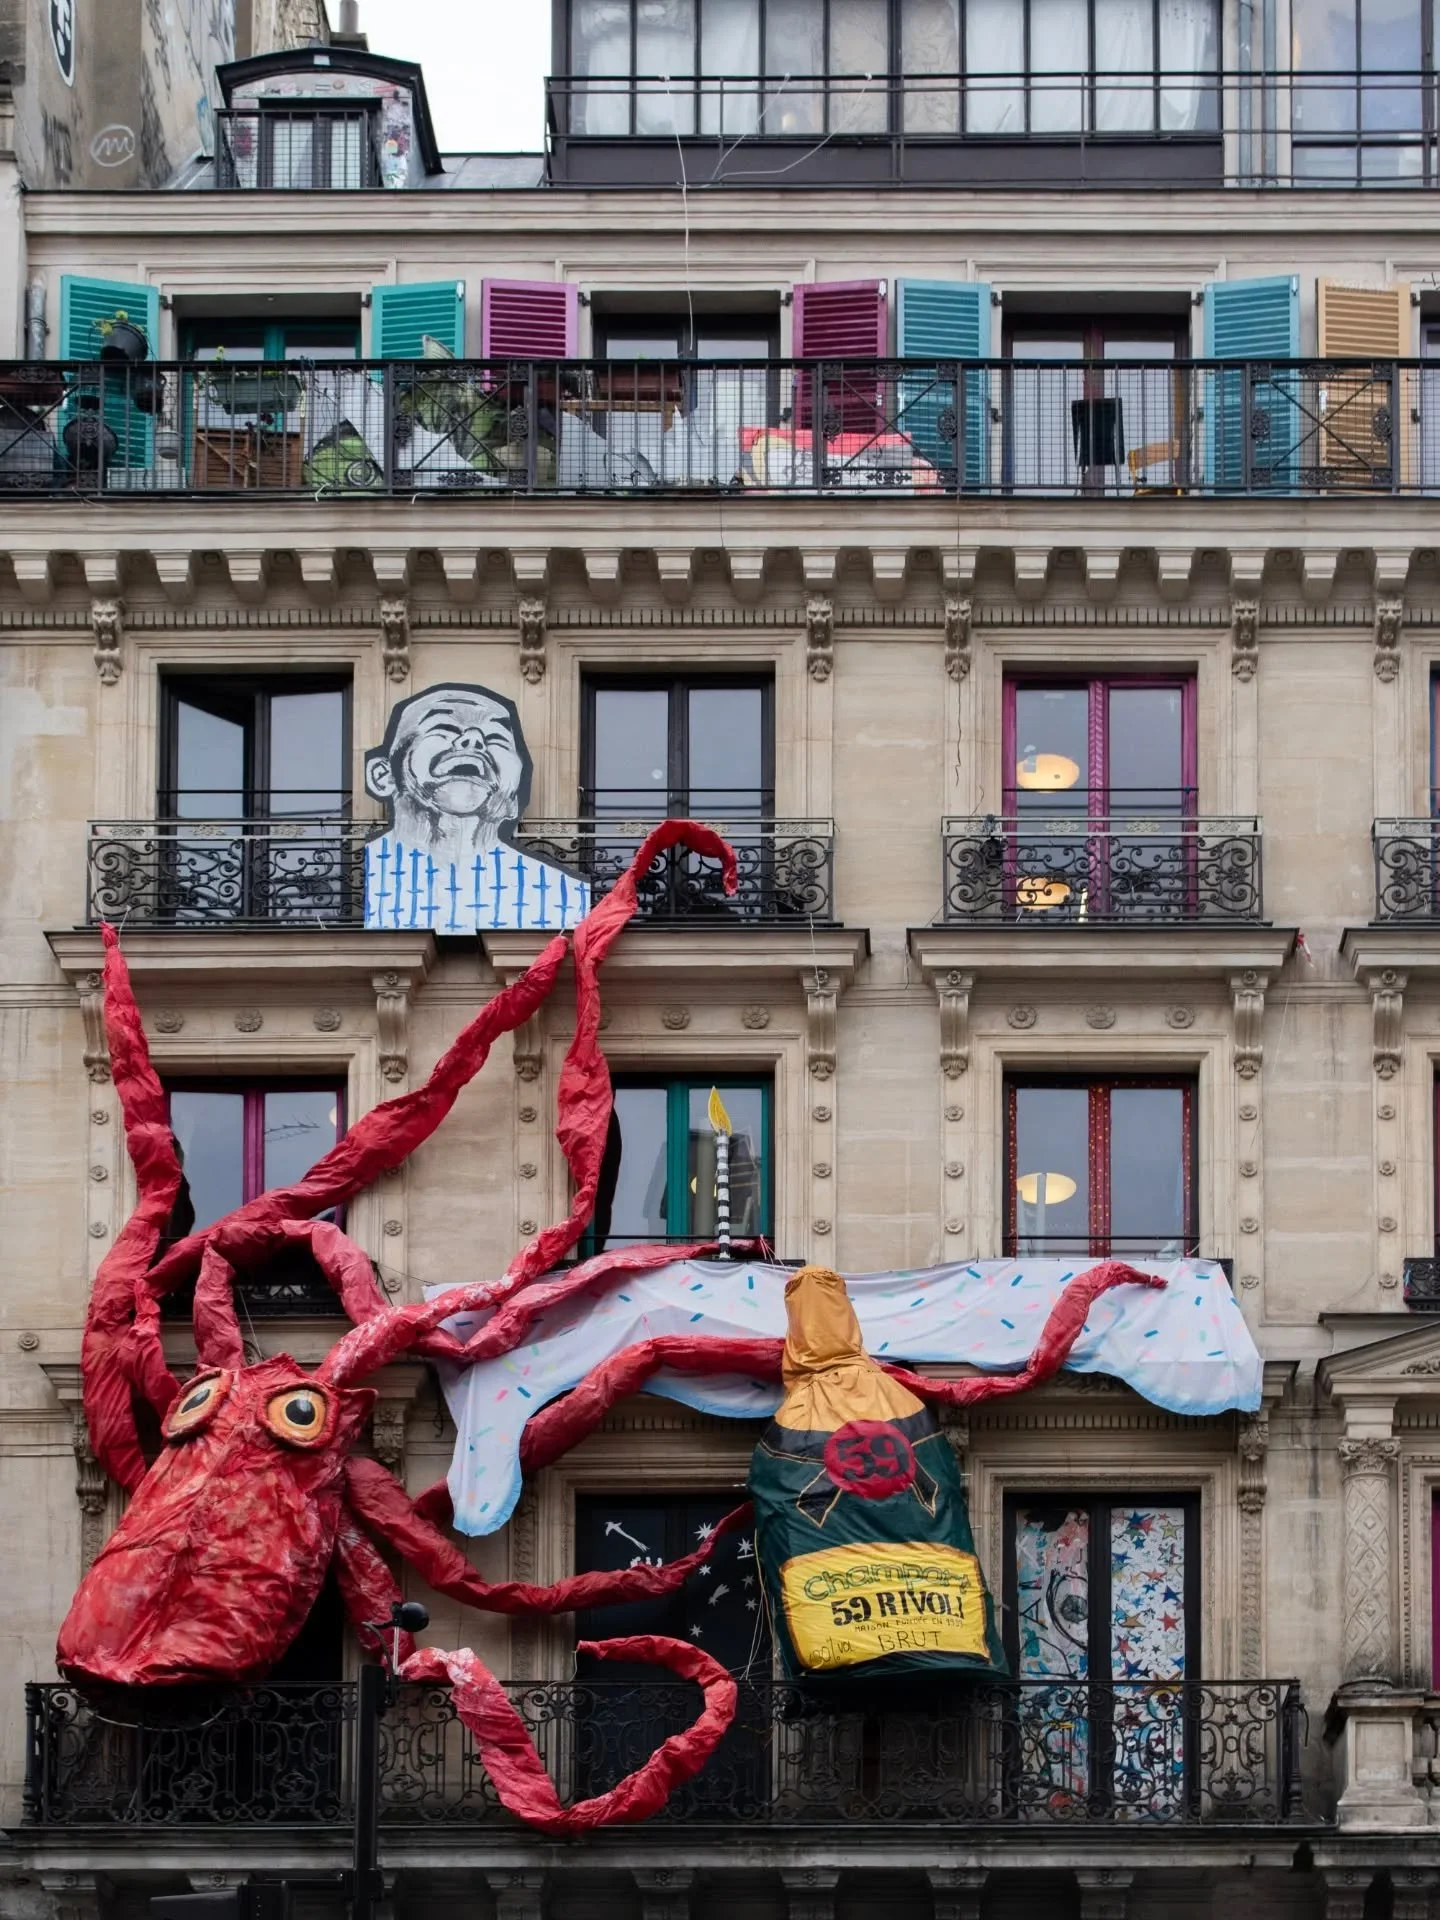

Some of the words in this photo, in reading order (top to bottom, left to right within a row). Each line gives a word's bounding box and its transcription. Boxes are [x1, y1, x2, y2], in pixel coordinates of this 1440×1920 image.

[837, 1434, 909, 1480] 59
[831, 1596, 872, 1626] 59
[876, 1590, 965, 1619] RIVOLI
[854, 1621, 889, 1632] MAISON
[931, 1617, 943, 1626] EN
[877, 1630, 943, 1651] BRUT
